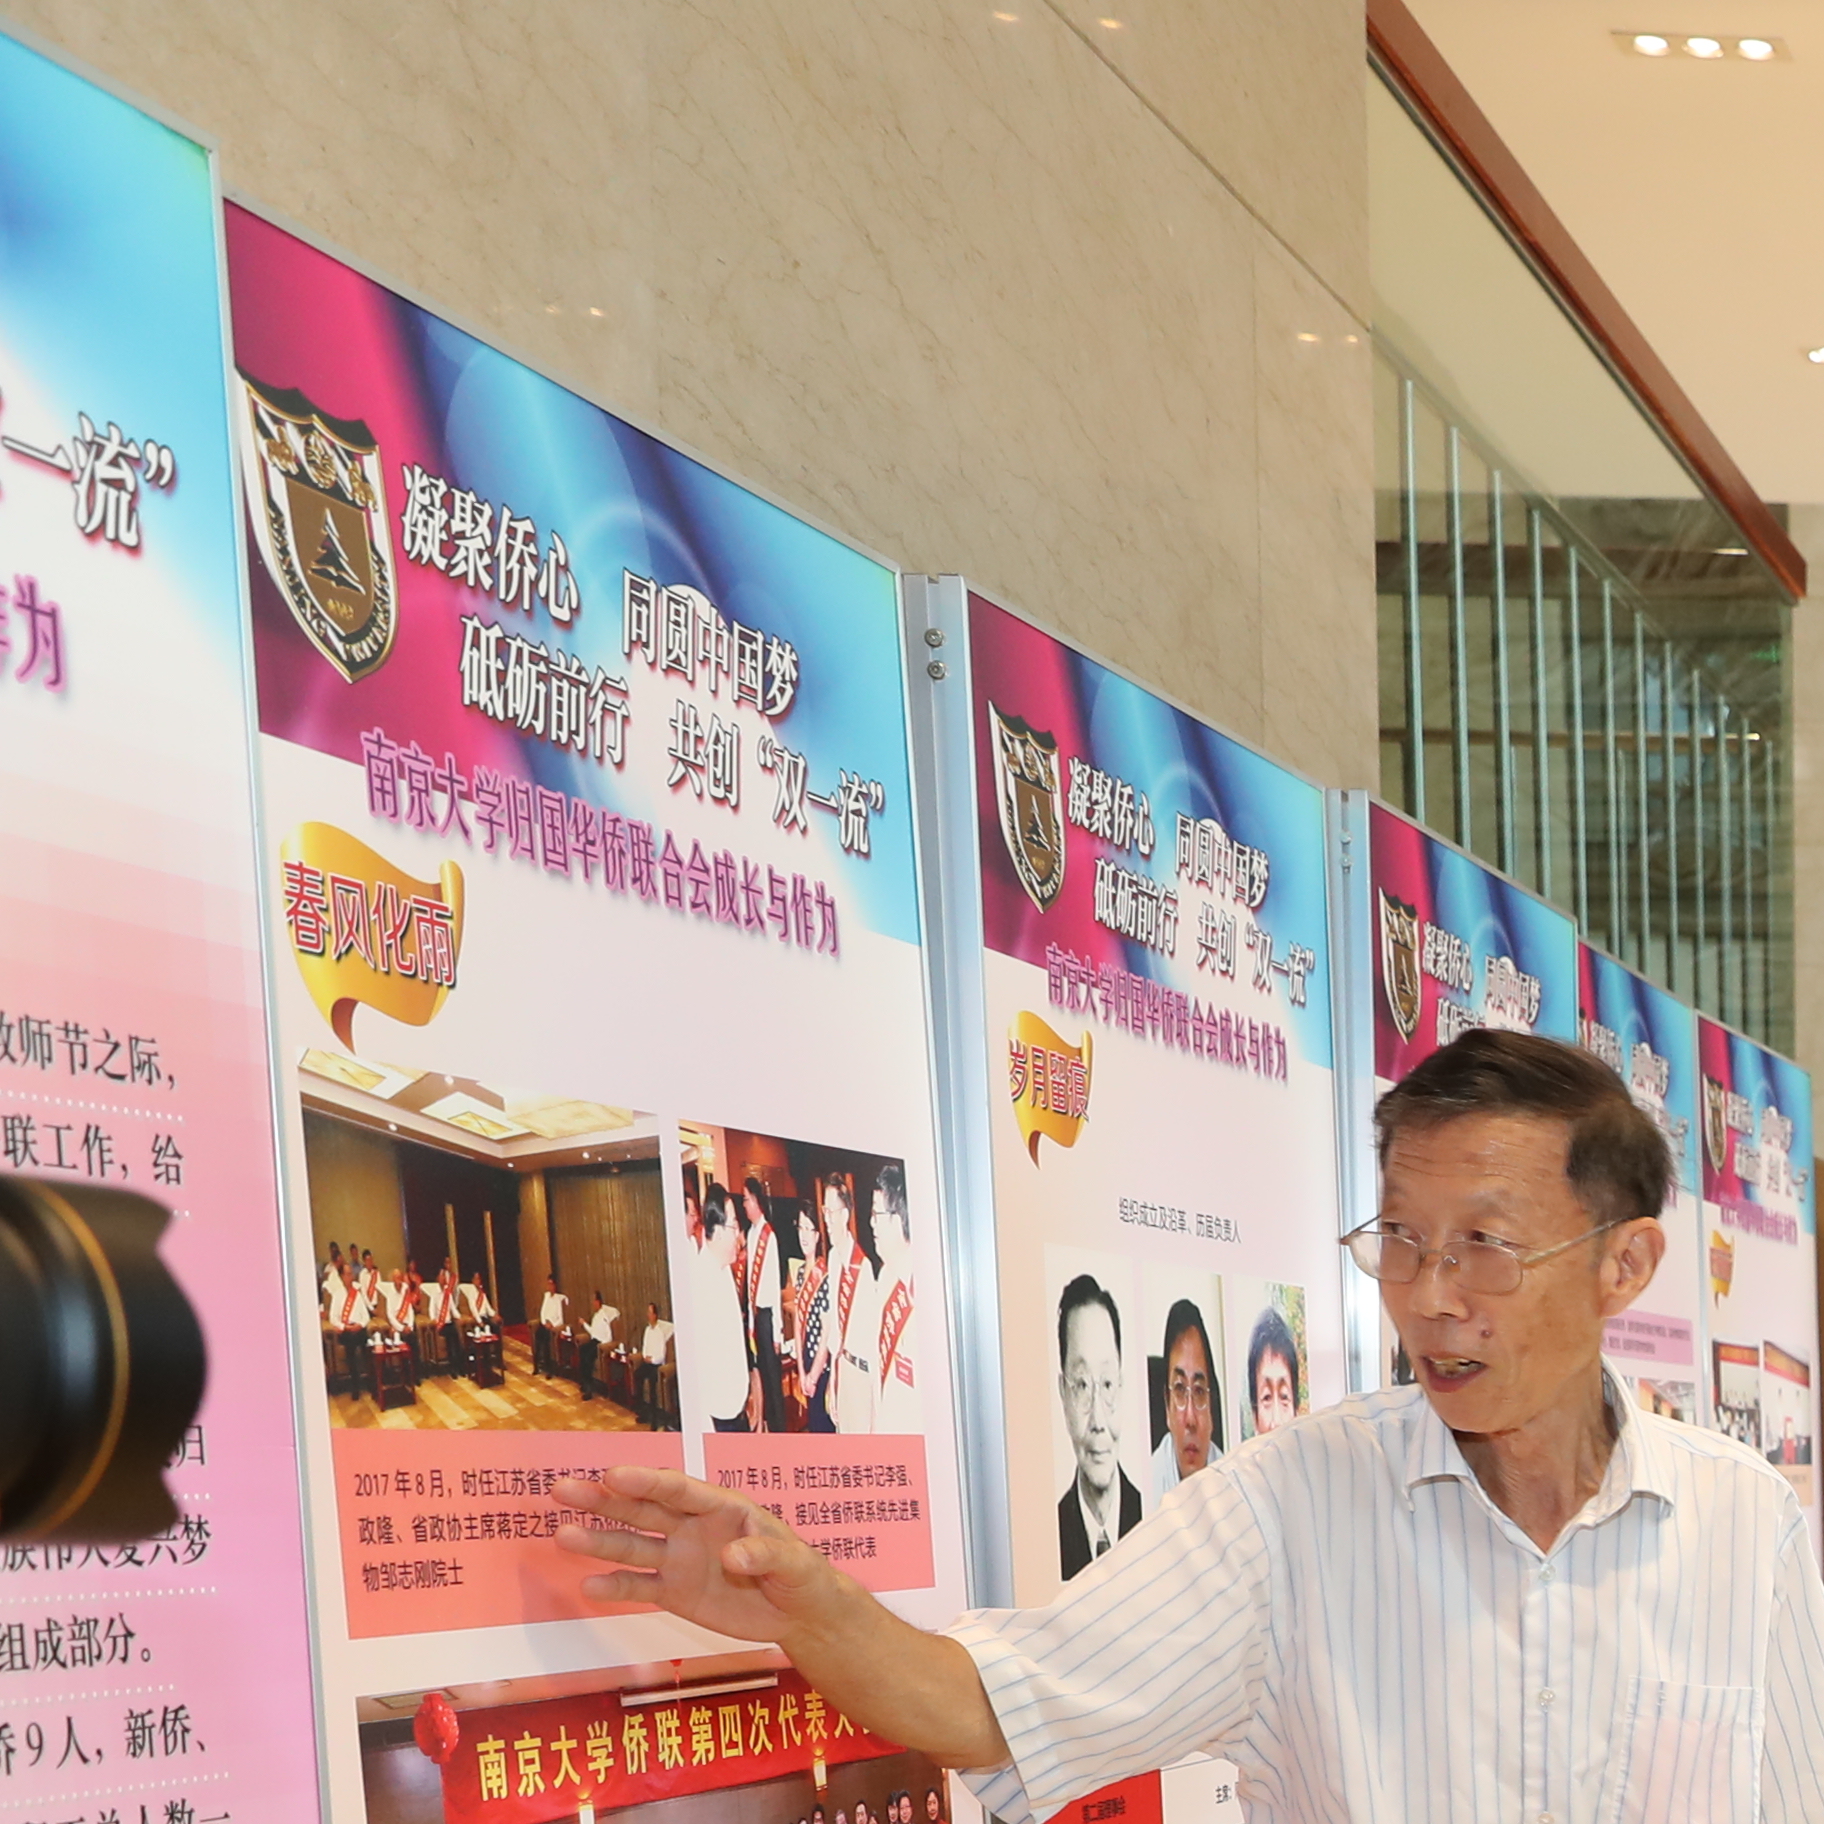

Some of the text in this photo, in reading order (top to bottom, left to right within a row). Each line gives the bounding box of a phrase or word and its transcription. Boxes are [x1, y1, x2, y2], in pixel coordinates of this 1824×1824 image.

[0, 573, 68, 708] 为
[400, 464, 579, 622] 凝聚侨心
[621, 567, 799, 718] 同圆中国梦
[459, 614, 630, 763] 砥砺前行
[361, 727, 841, 957] 南京大学归国华侨联合会成长与作为
[1067, 756, 1156, 859] 凝聚侨心
[1174, 810, 1271, 908] 同圆中国梦
[282, 860, 457, 988] 春风化雨
[1093, 857, 1179, 958] 砥砺前行
[1007, 1037, 1092, 1123] 岁月留痕
[476, 1688, 872, 1801] 南京大学侨联第四次代表大
